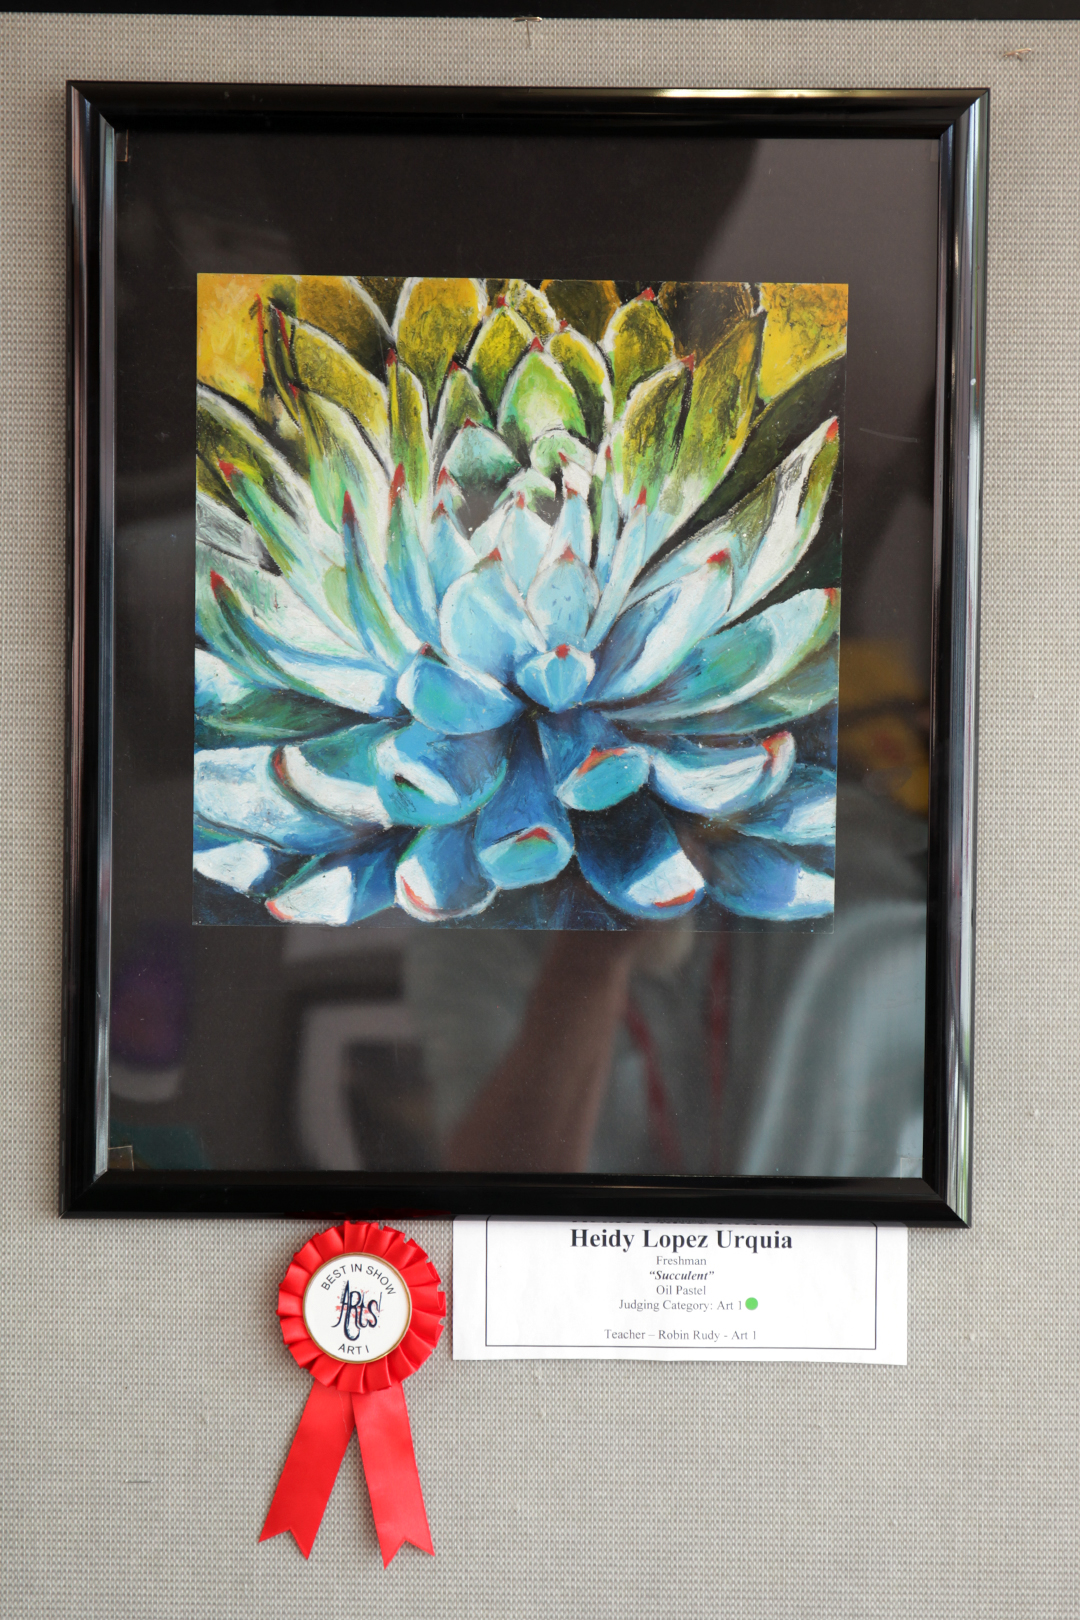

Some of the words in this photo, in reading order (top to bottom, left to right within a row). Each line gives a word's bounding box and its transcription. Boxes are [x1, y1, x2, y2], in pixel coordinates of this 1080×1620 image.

[570, 1229, 635, 1252] Heidy
[642, 1229, 709, 1252] Lopez
[717, 1230, 793, 1253] Urquia
[656, 1255, 707, 1266] Freshman
[321, 1265, 347, 1291] BEST
[350, 1263, 363, 1273] IN
[365, 1265, 397, 1296] SHOW
[656, 1284, 672, 1295] Oil
[676, 1285, 706, 1296] Pastel
[618, 1299, 660, 1312] Judging
[662, 1299, 713, 1313] Category:
[716, 1300, 734, 1310] Art
[604, 1329, 646, 1340] Teacher
[658, 1329, 690, 1340] Robin
[693, 1329, 720, 1343] Rudy
[731, 1330, 748, 1341] Art
[337, 1343, 362, 1355] ART
